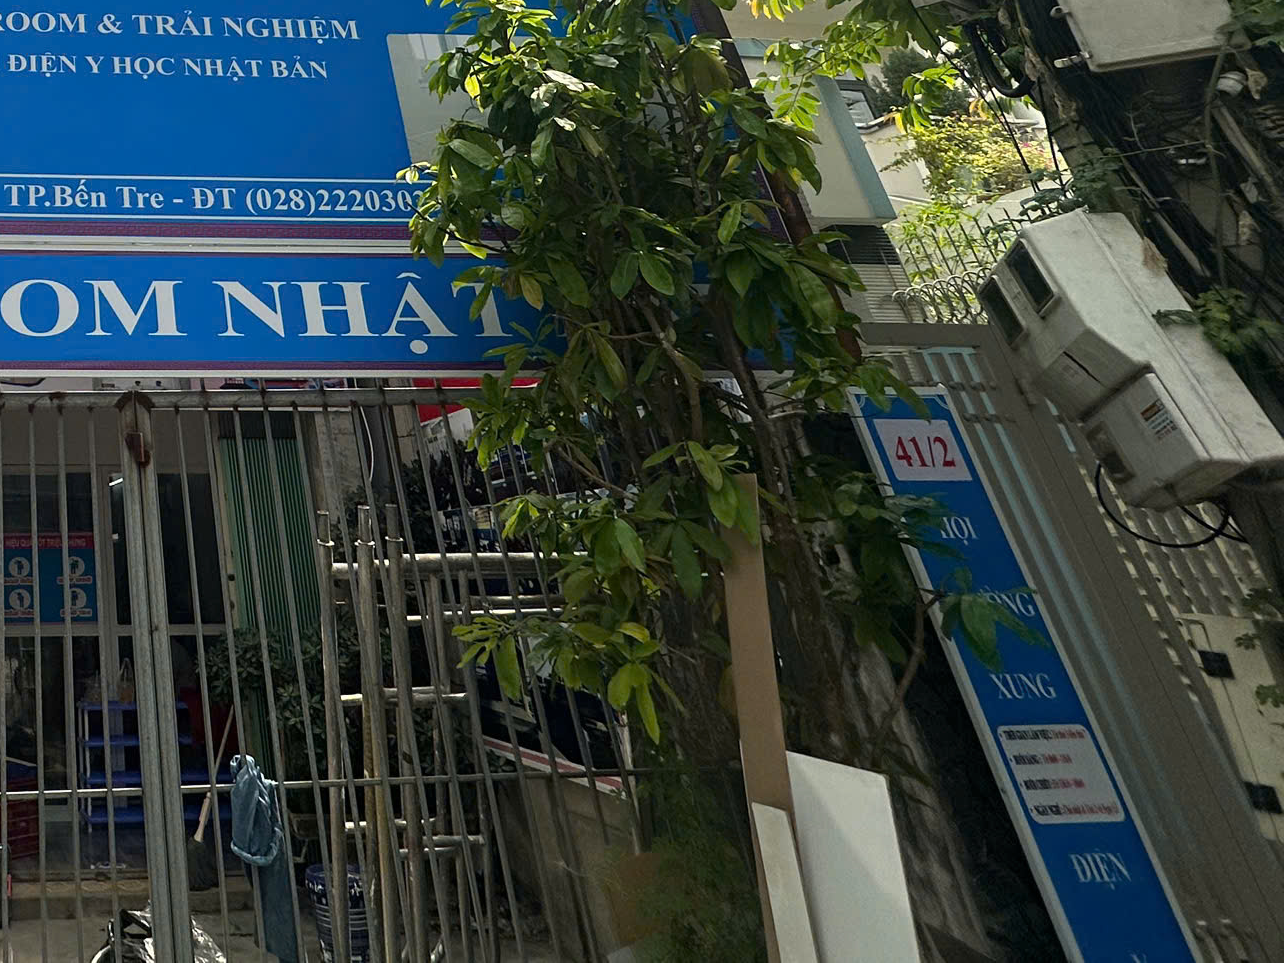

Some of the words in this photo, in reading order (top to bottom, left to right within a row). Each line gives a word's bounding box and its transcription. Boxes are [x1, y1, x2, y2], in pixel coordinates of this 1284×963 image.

[97, 13, 123, 34] &
[132, 10, 212, 37] TRẢI
[221, 15, 361, 44] NGHIỆM
[7, 51, 77, 77] ĐIỆN
[85, 56, 105, 74] Y
[113, 57, 176, 79] HỌC
[183, 57, 263, 82] NHẬT
[272, 55, 328, 80] BẢN
[4, 179, 107, 208] TP.Bến
[116, 186, 164, 210] Tre
[192, 187, 237, 211] ĐT
[212, 272, 514, 355] NHẬT
[894, 435, 957, 470] 41/2
[989, 672, 1057, 700] XUNG
